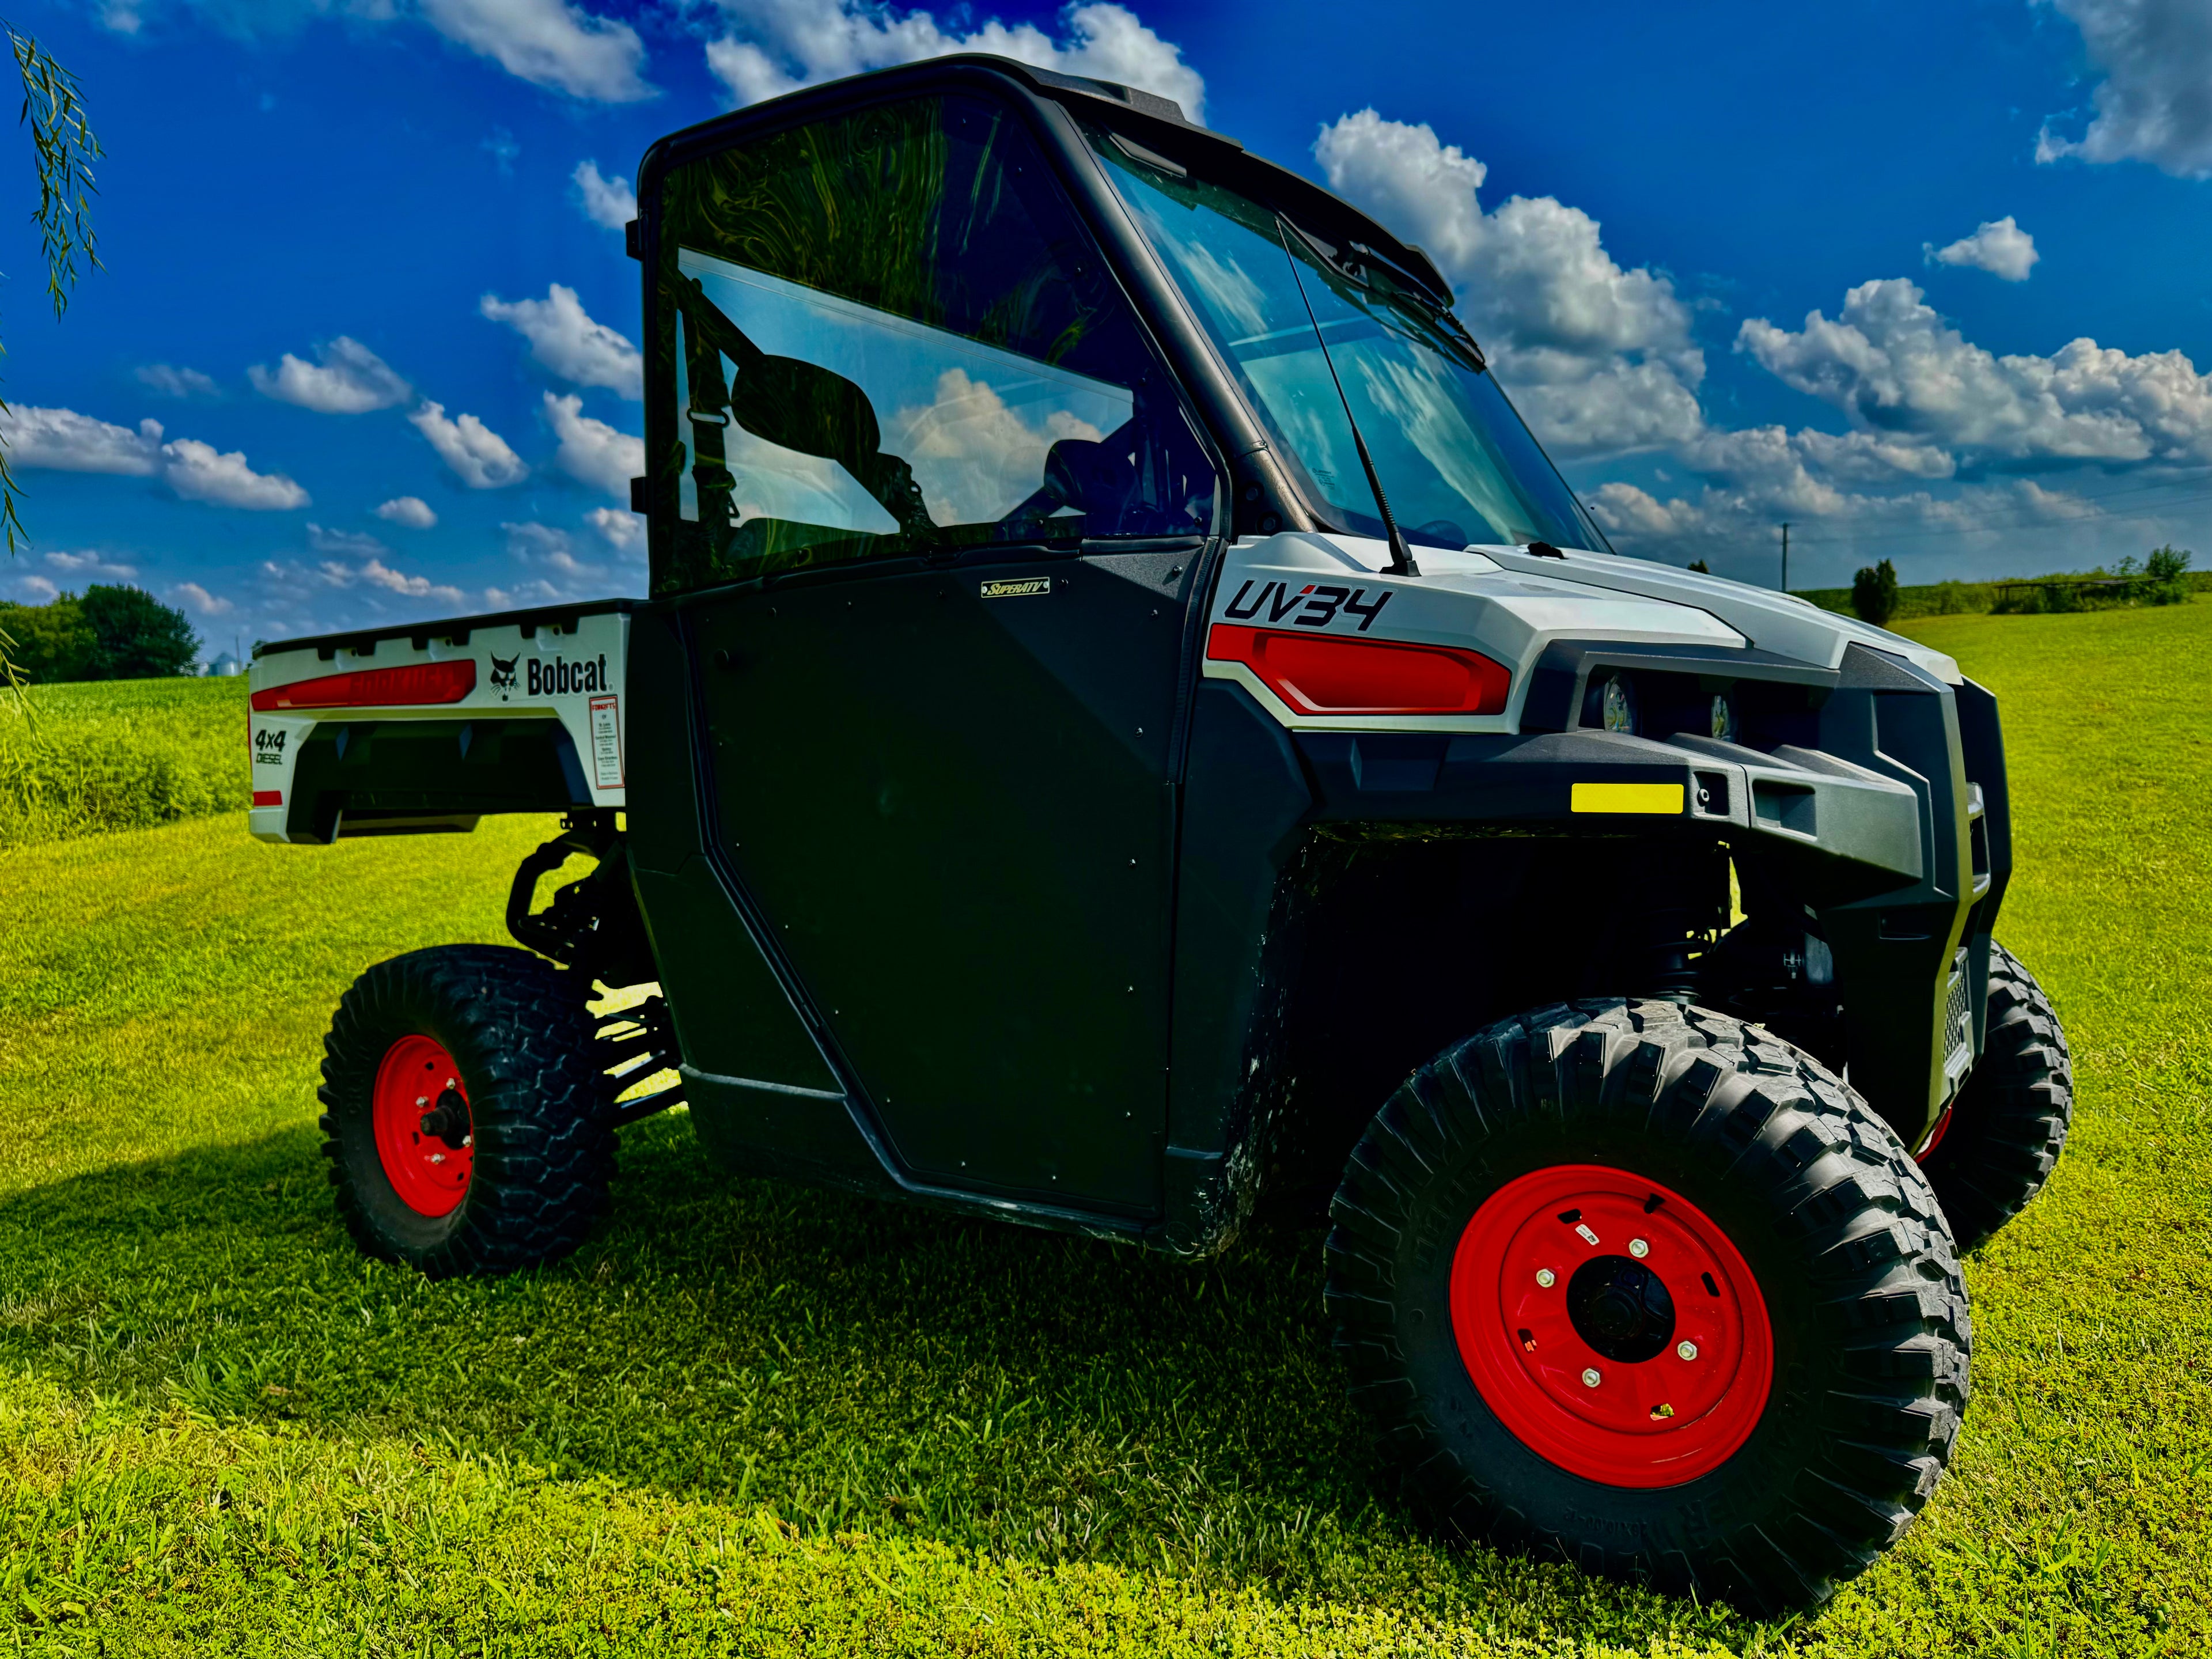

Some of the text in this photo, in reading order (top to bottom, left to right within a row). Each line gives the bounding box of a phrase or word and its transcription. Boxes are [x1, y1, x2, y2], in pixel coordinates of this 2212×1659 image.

[1224, 579, 1393, 631] UV34
[528, 654, 607, 696] Bobcat
[255, 729, 286, 752] 4x4
[256, 753, 283, 766] DIESEL
